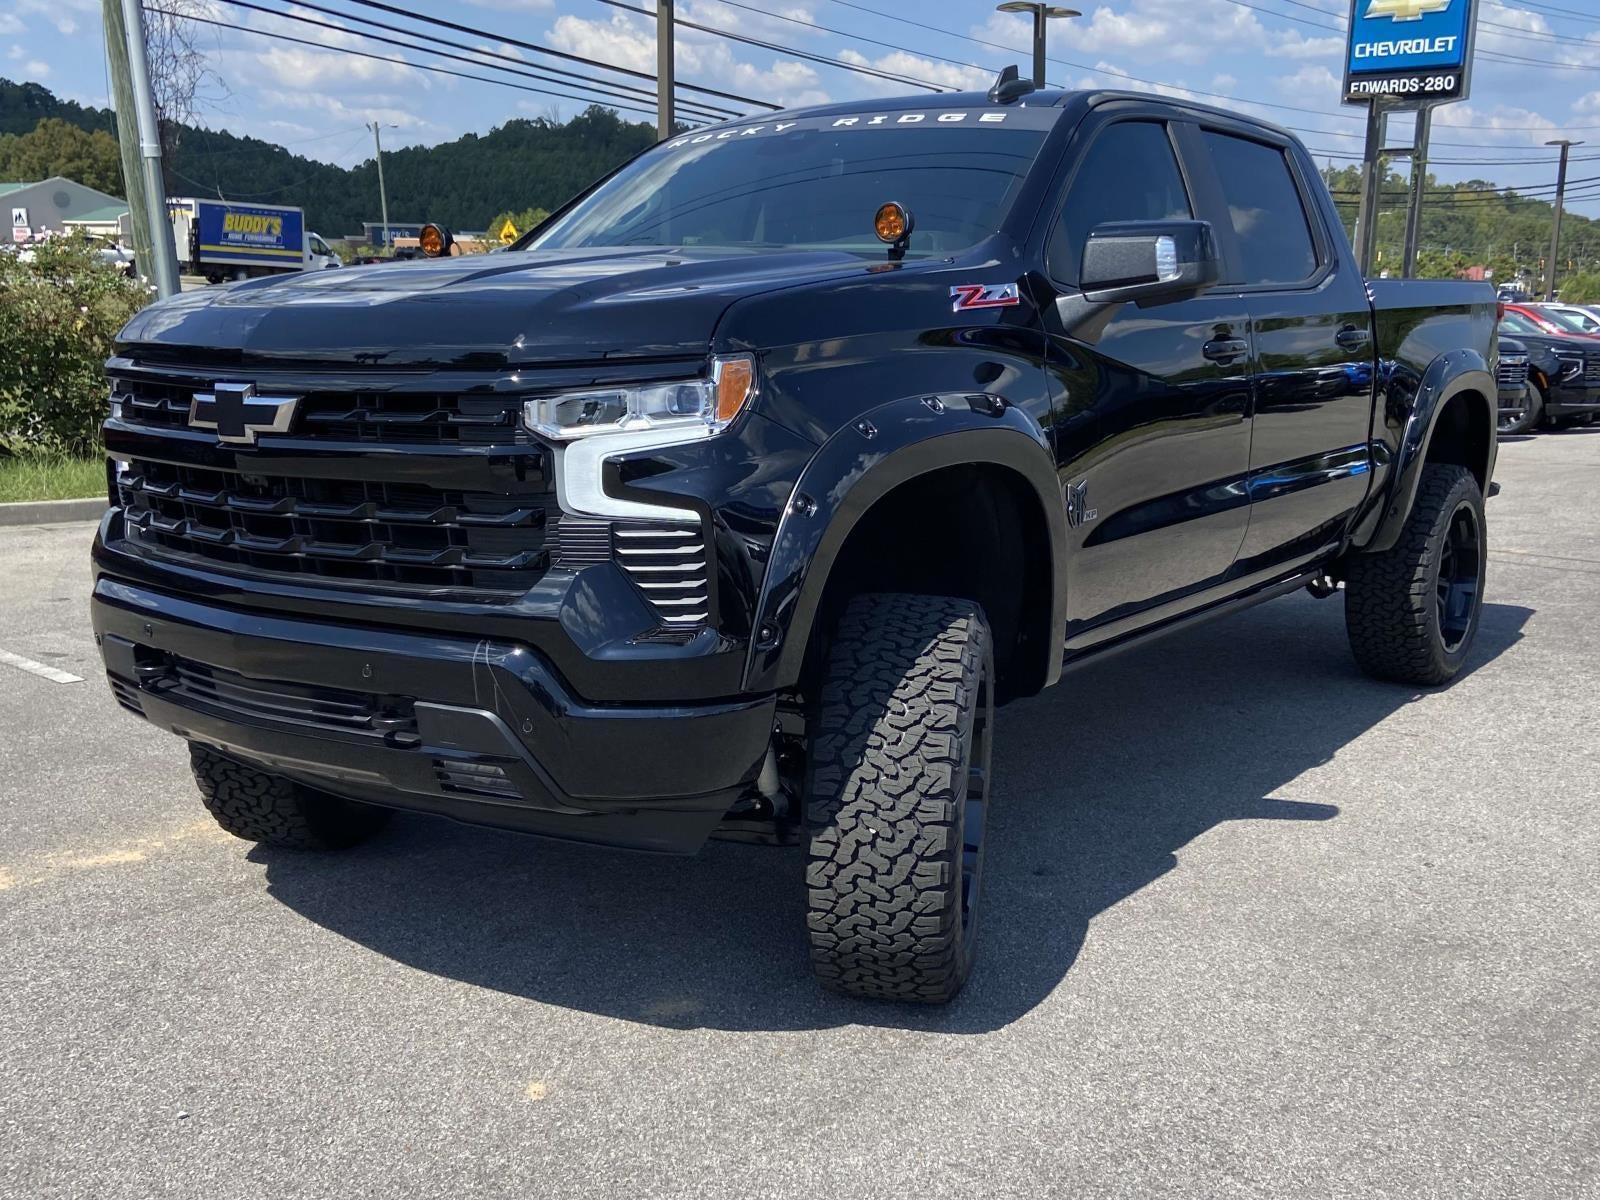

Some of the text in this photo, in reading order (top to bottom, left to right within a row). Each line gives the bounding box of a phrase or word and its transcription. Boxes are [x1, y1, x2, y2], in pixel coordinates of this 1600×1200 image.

[1354, 36, 1457, 58] CHEVROLET
[1350, 75, 1455, 94] EDWARDS-280
[668, 113, 1007, 149] ROCKY RIDGE
[223, 214, 282, 235] BUDDY'S
